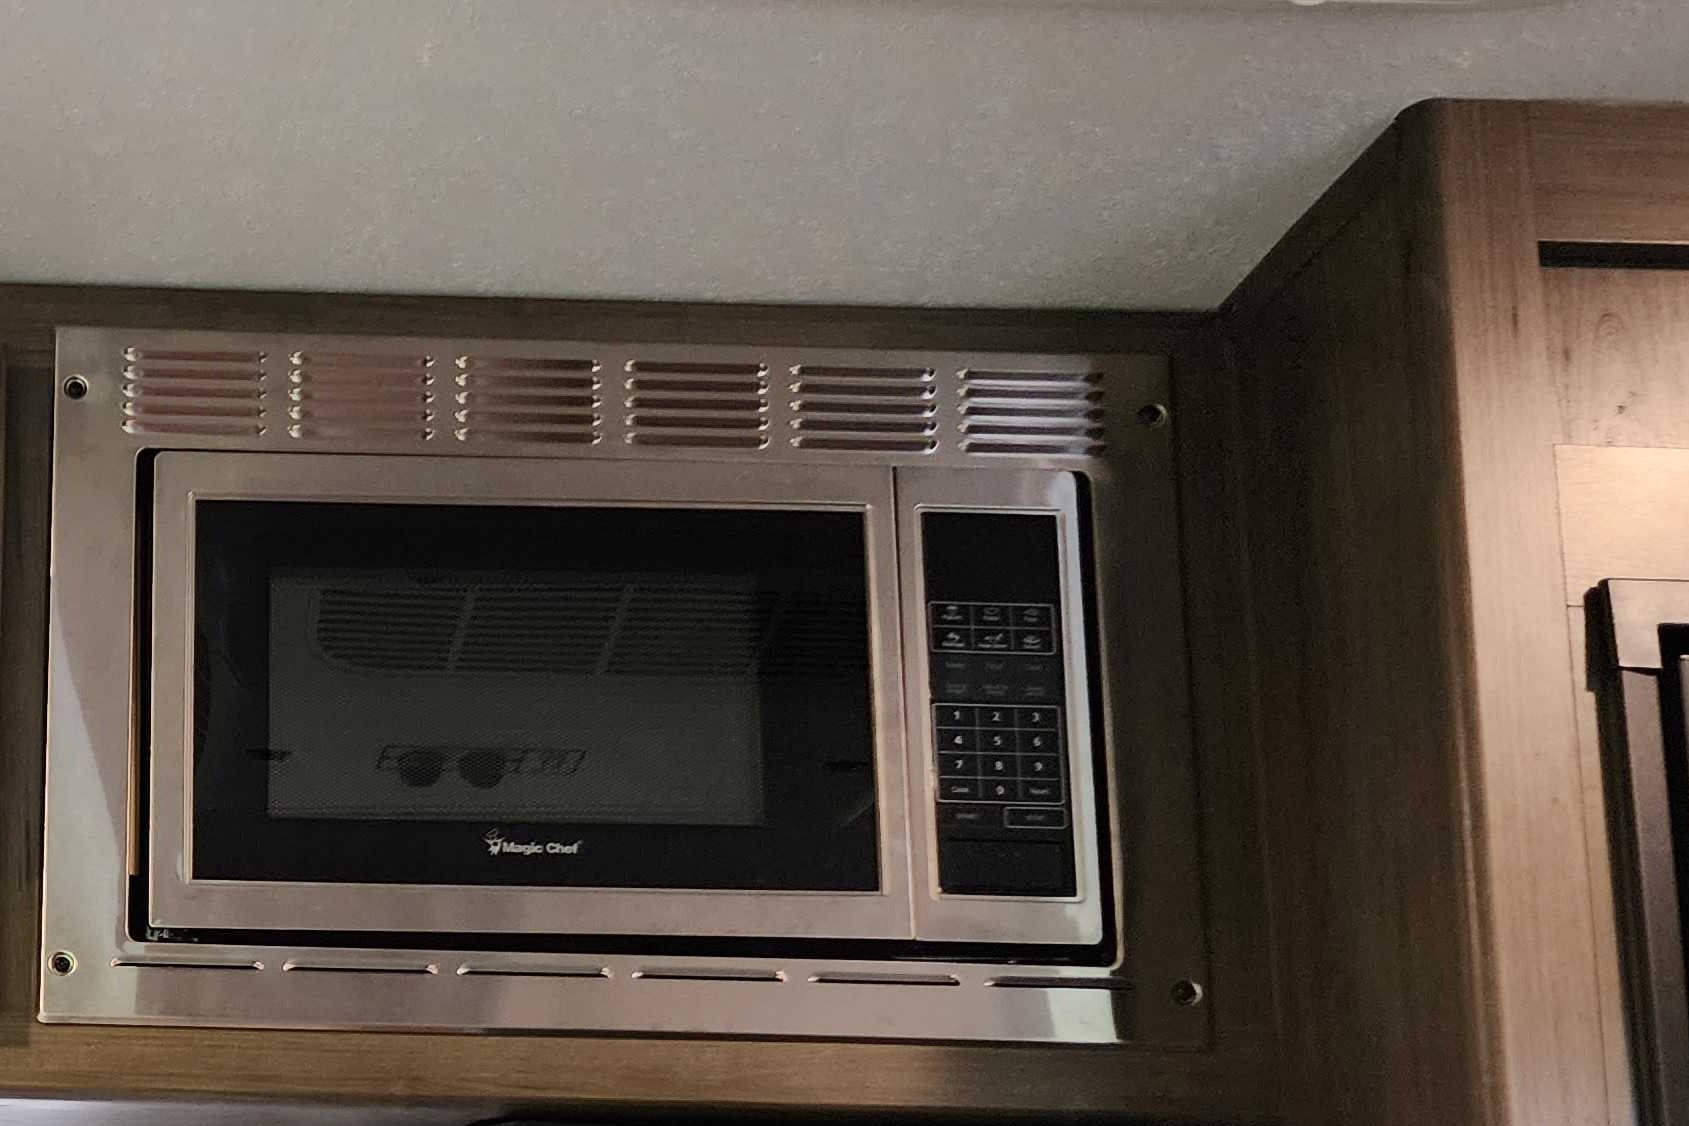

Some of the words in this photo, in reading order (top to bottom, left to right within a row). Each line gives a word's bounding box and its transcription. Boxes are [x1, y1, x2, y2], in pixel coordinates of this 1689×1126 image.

[992, 712, 1000, 721] 2
[1032, 713, 1040, 722] 3
[954, 736, 963, 744] 4
[993, 736, 1001, 745] 5
[1033, 737, 1042, 746] 6
[955, 760, 963, 768] 7
[995, 761, 1003, 770] 8
[1034, 762, 1043, 771] 9
[503, 842, 543, 855] Magic
[546, 843, 578, 853] Chef
